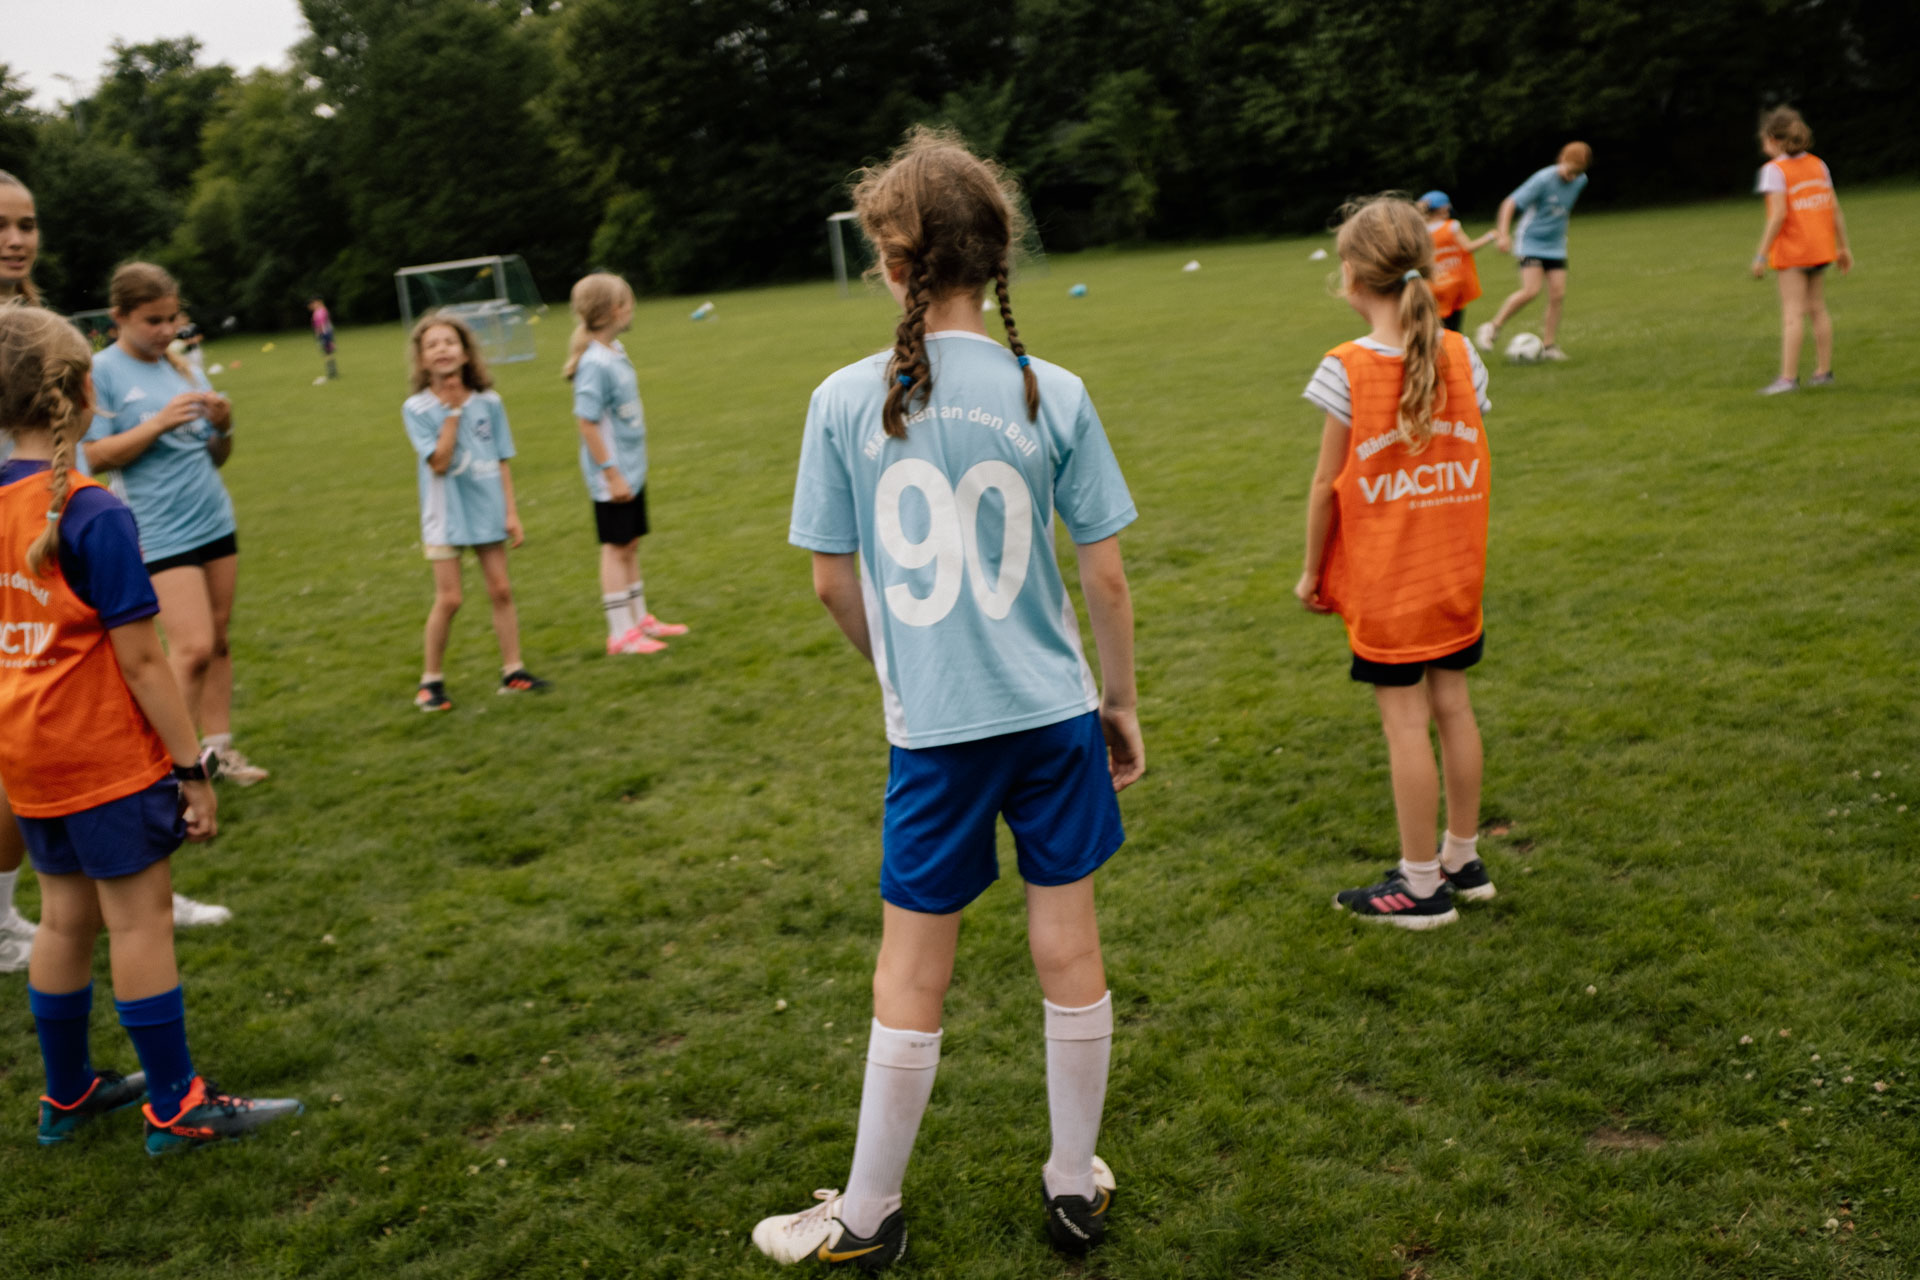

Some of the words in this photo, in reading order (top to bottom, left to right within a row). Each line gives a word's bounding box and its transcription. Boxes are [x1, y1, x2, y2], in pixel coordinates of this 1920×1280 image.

[863, 407, 937, 460] Mähen
[941, 406, 963, 419] an
[968, 406, 1004, 430] den
[1005, 421, 1037, 457] Ball
[1357, 458, 1480, 504] VIACTIV
[875, 458, 1033, 627] 90
[0, 621, 54, 655] CTIV
